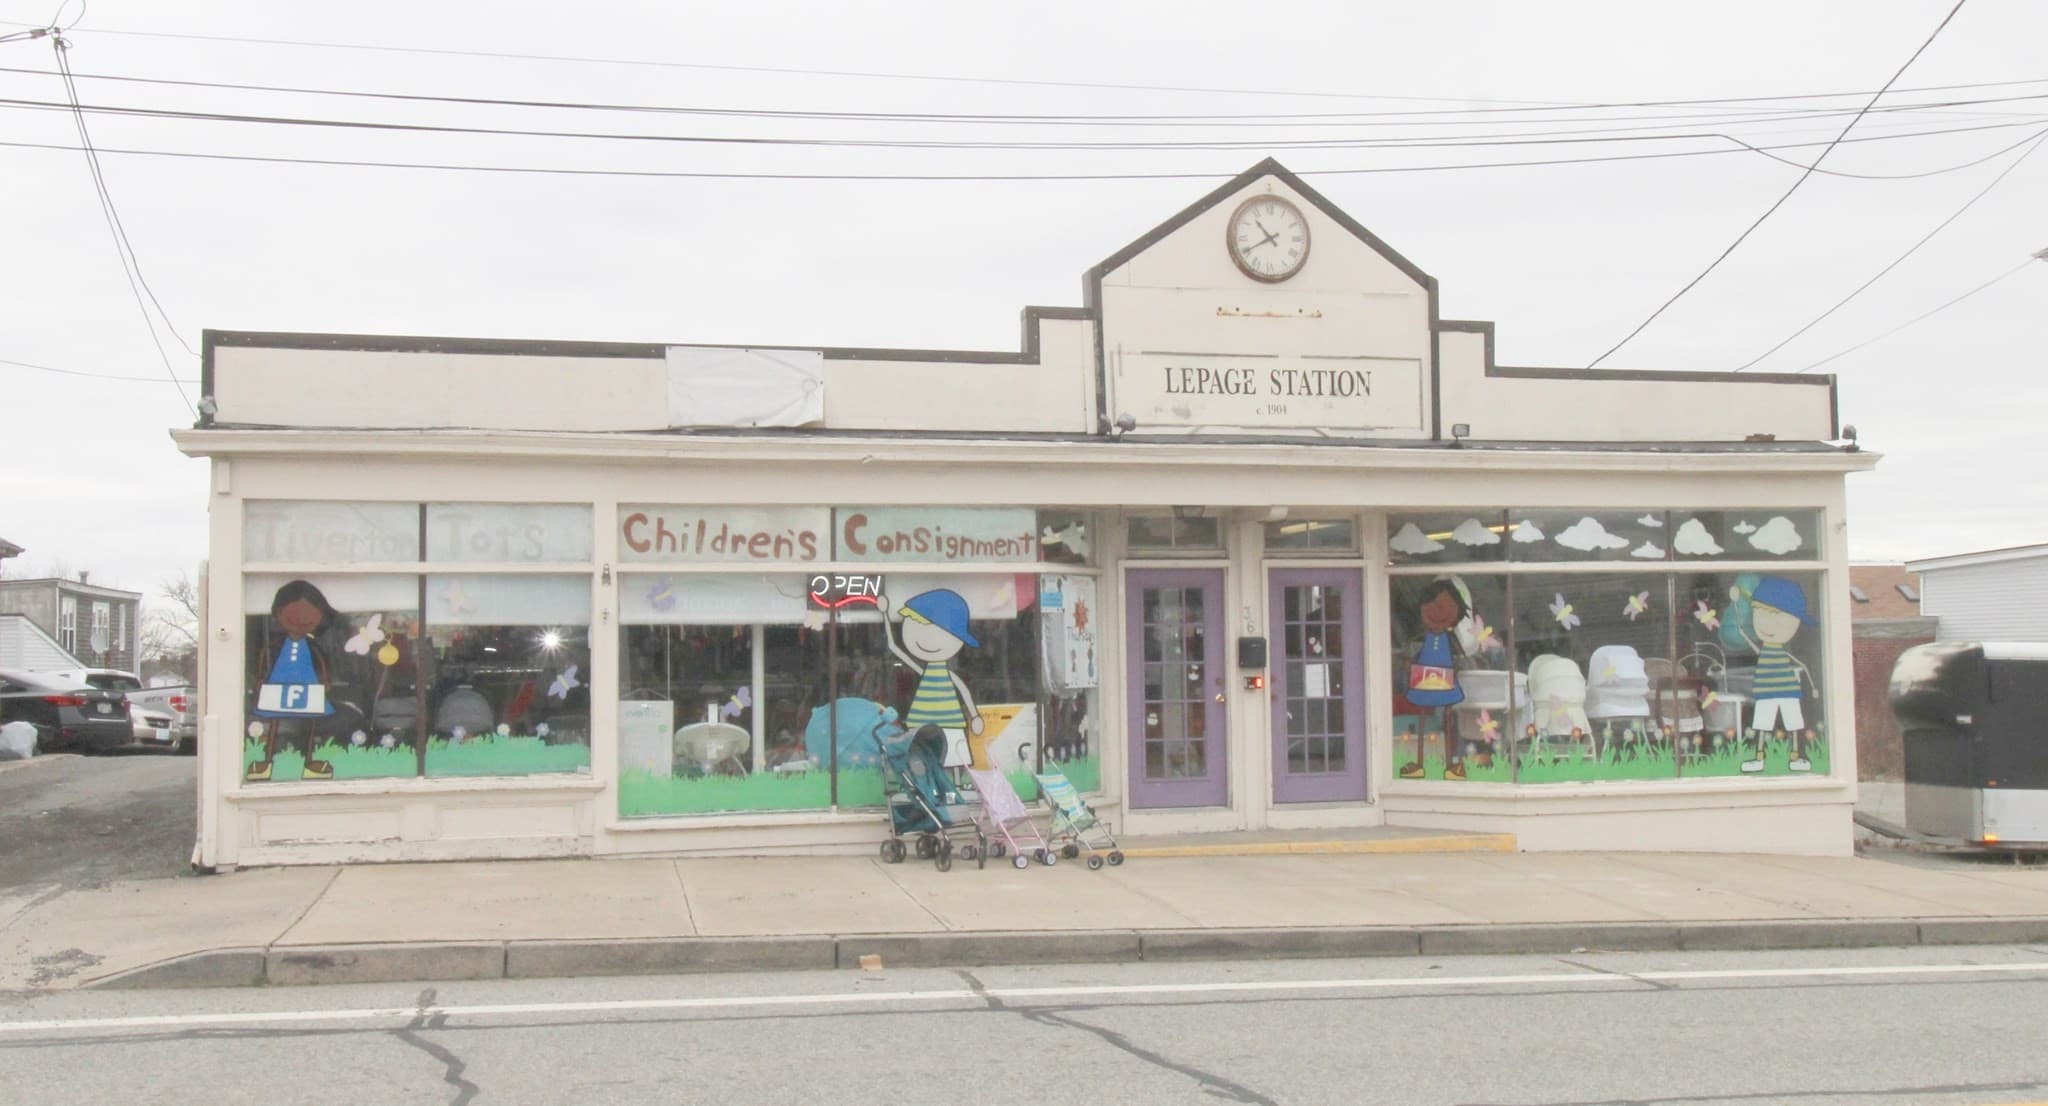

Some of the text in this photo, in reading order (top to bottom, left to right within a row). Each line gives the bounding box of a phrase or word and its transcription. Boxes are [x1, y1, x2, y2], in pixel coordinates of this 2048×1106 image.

[1164, 367, 1372, 397] LEPAGE STATION
[1267, 403, 1288, 416] 1904
[623, 512, 1035, 561] Children's Consignment
[811, 575, 881, 597] OPEN
